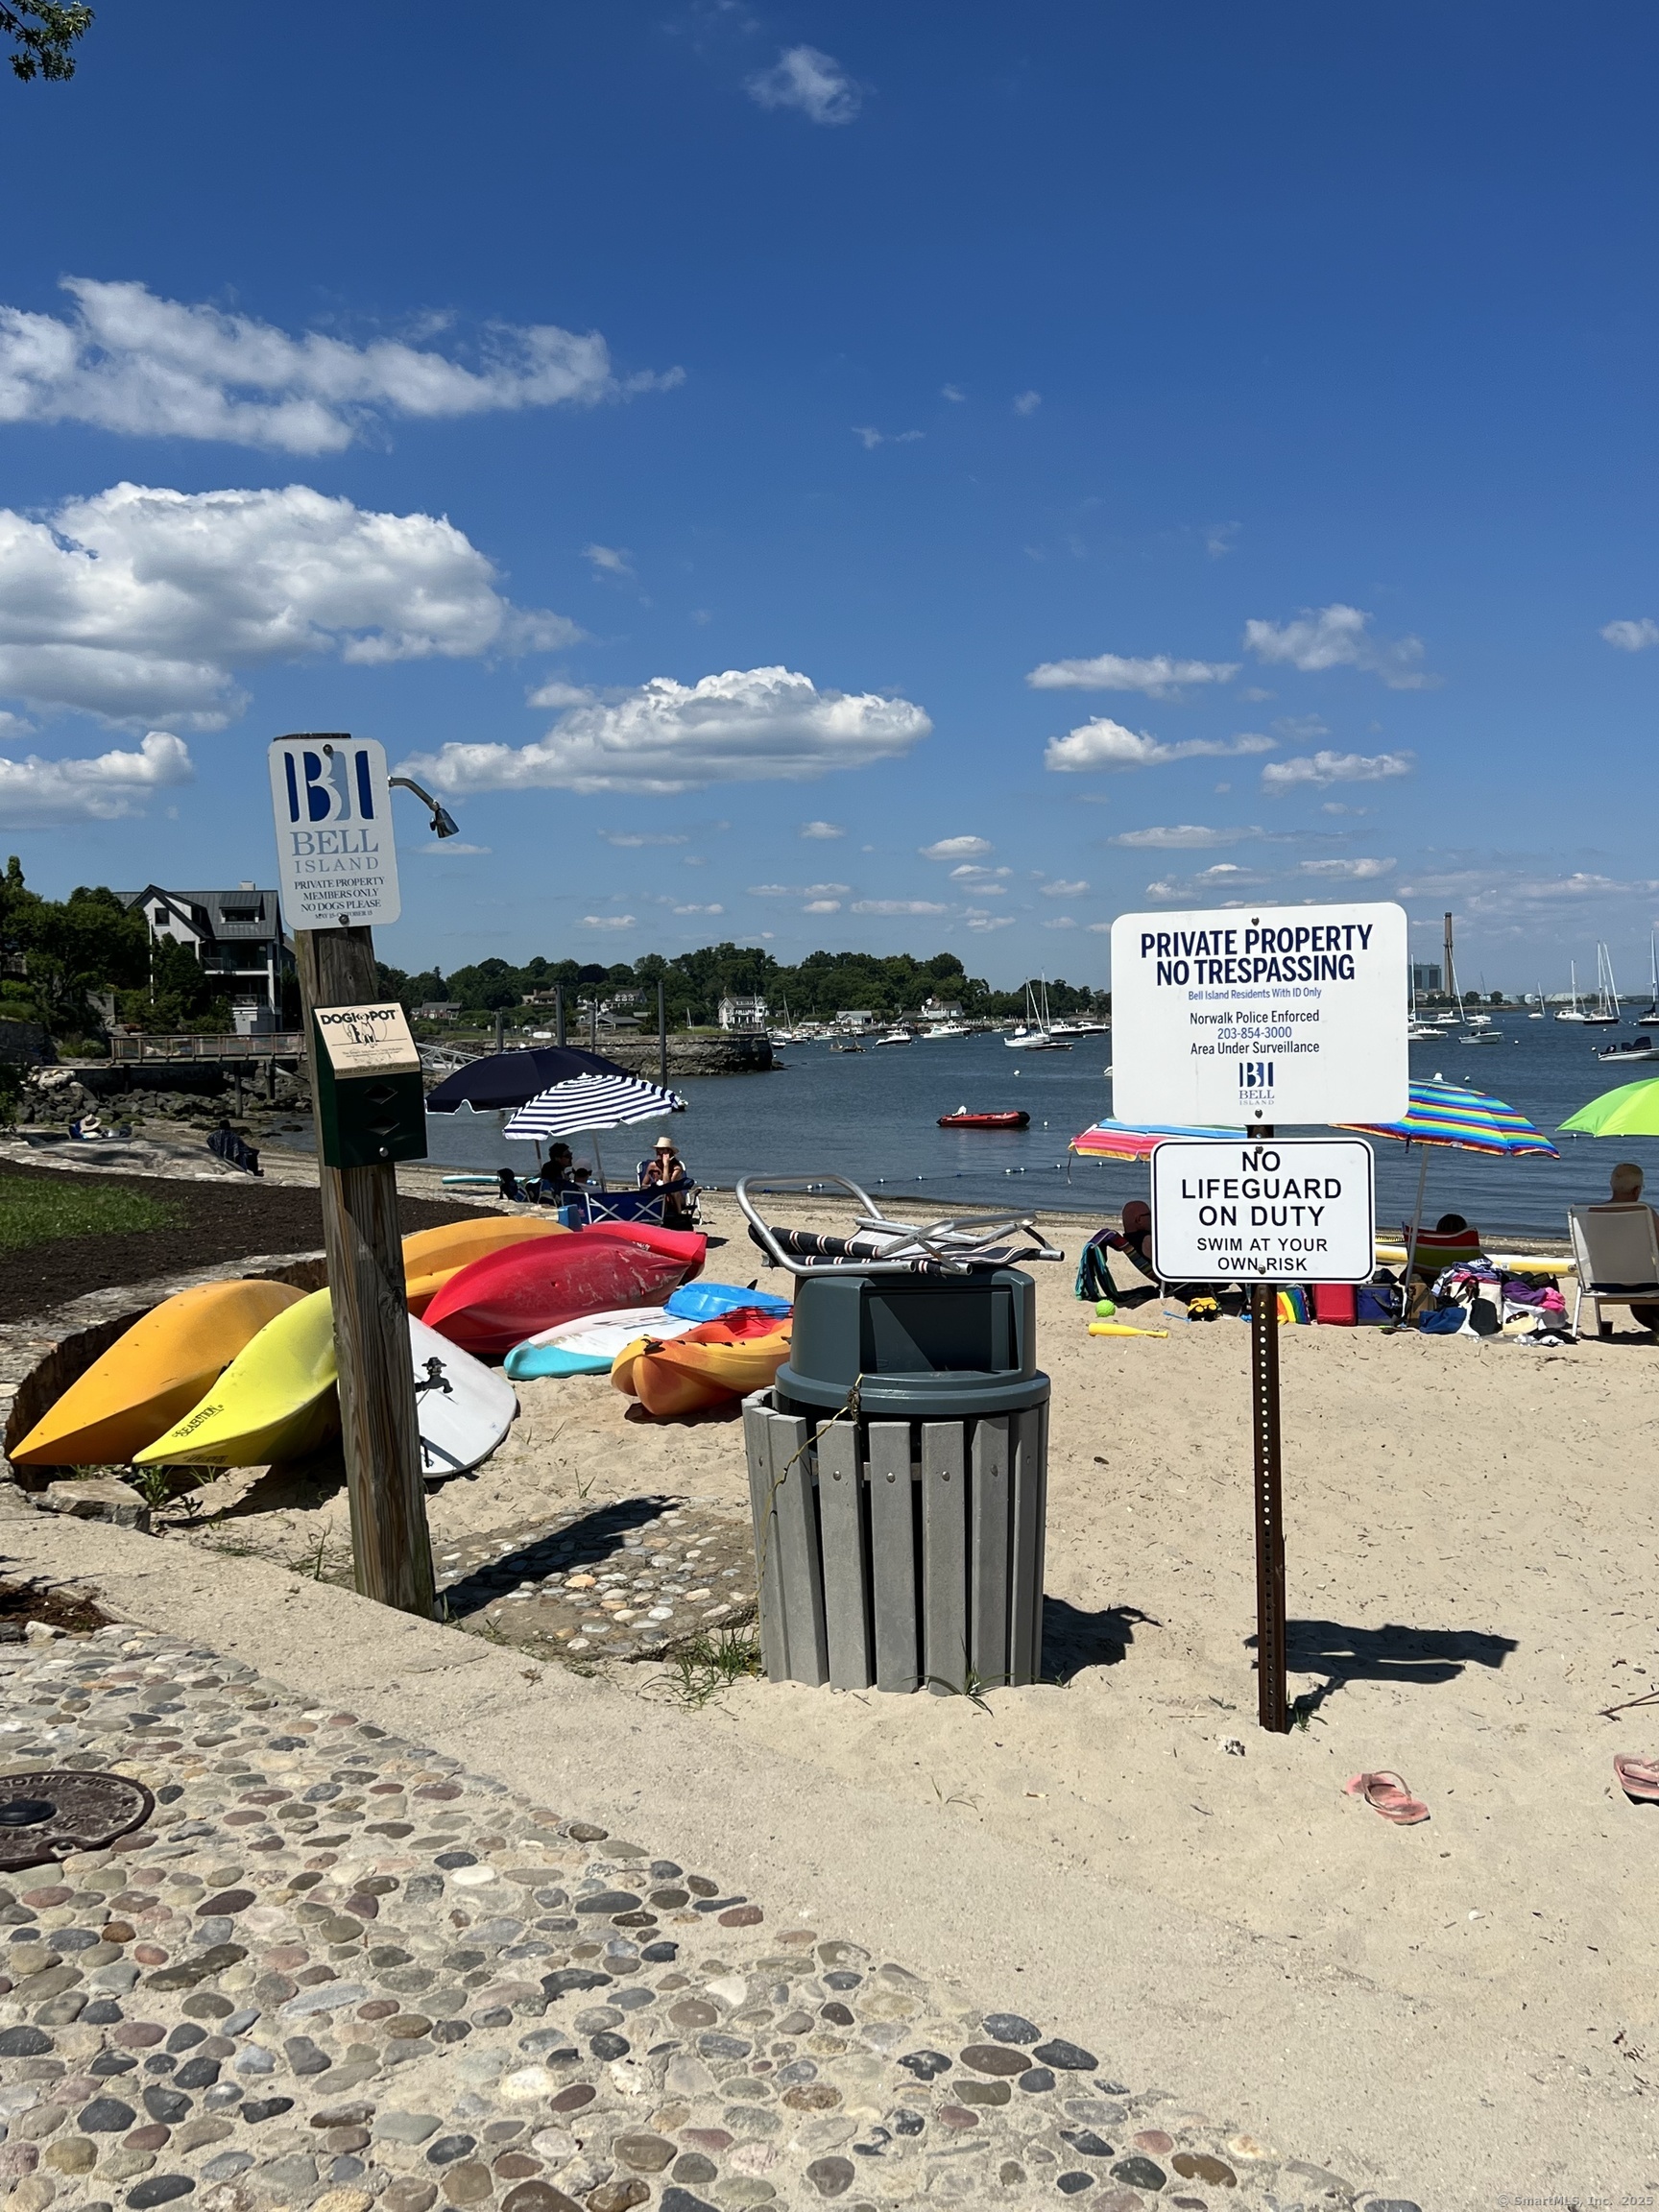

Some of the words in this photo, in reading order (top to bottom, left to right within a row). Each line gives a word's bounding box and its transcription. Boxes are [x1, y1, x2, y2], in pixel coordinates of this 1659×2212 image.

[290, 829, 379, 856] BELL
[295, 857, 379, 874] ISLAND
[294, 879, 335, 890] PRIVATE
[336, 877, 385, 887] PROPERTY
[303, 890, 352, 901] MEMBERS
[353, 888, 379, 898] ONLY
[301, 902, 316, 912] NO
[318, 902, 346, 911] DOGS
[347, 900, 382, 909] PLEASE
[1141, 929, 1238, 958] PRIVATE
[1244, 924, 1373, 955] PROPERTY
[1156, 961, 1190, 986] NO
[1193, 954, 1356, 984] TRESPASSING
[1189, 991, 1204, 1000] Bell
[1205, 990, 1229, 999] Island
[1231, 989, 1270, 998] Residents
[1271, 988, 1291, 998] With
[1292, 988, 1302, 998] ID
[1303, 987, 1322, 998] Only
[1190, 1011, 1234, 1024] Norwalk
[1236, 1011, 1268, 1023] Police
[1271, 1009, 1320, 1022] Enforced
[1217, 1026, 1292, 1040] 203-854-3000
[1190, 1043, 1214, 1055] Area
[1217, 1042, 1249, 1054] Under
[1252, 1041, 1320, 1054] Surveillance
[1238, 1090, 1275, 1099] BELL
[1242, 1151, 1281, 1172] NO
[1182, 1178, 1342, 1199] LIFEGUARD
[1198, 1205, 1237, 1226] ON
[1251, 1206, 1325, 1227] DUTY
[1196, 1238, 1242, 1251] SWIM
[1249, 1238, 1271, 1251] AT
[1278, 1238, 1328, 1252] YOUR
[1217, 1257, 1259, 1271] OWN
[1266, 1258, 1308, 1271] RISK
